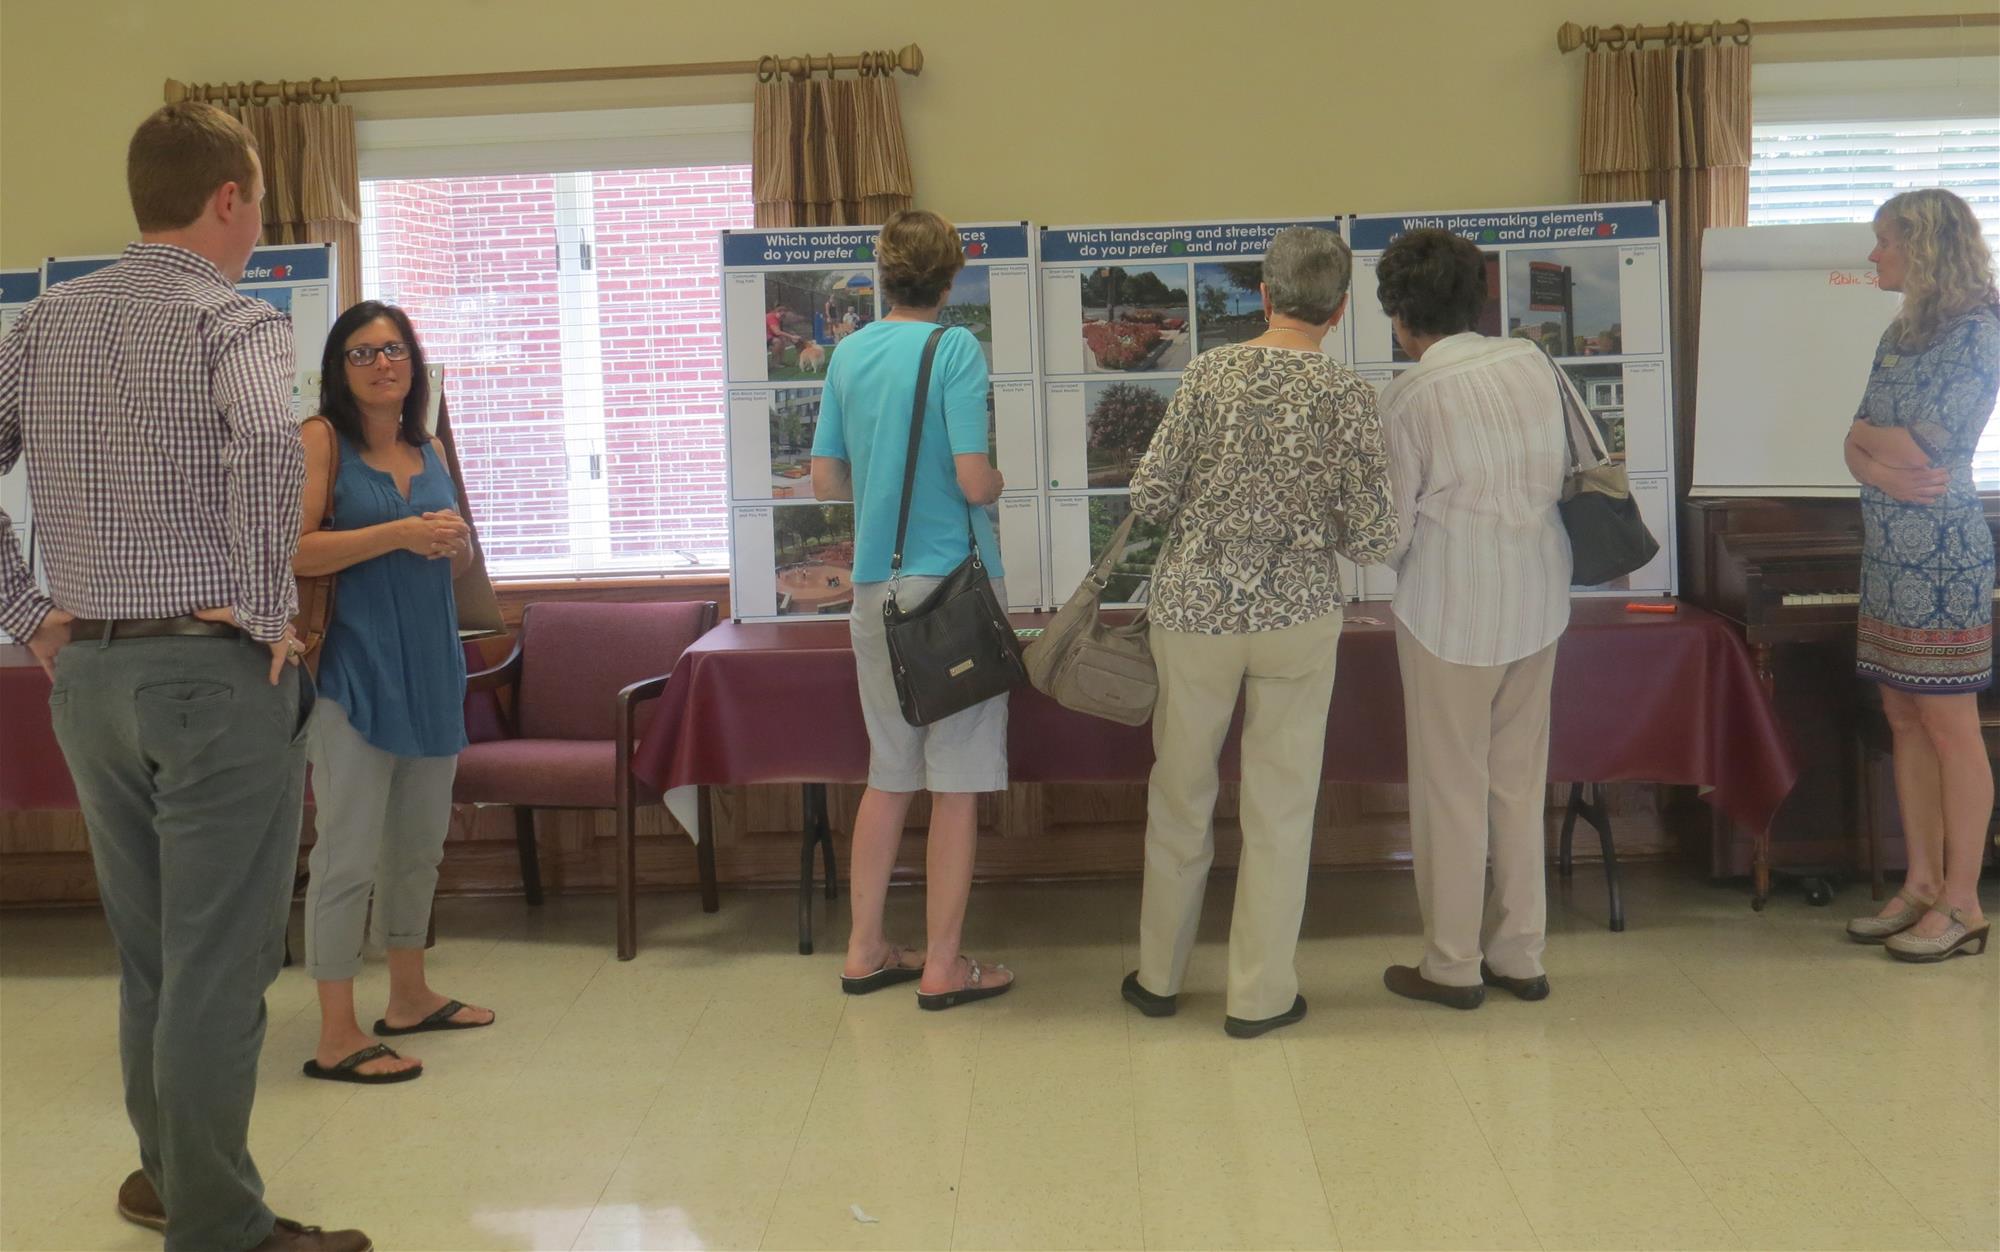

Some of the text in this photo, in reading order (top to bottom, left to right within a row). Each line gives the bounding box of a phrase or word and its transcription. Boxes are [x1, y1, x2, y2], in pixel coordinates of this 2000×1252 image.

[1403, 210, 1604, 231] Which placemaking elements
[1067, 231, 1107, 244] Which
[1111, 228, 1193, 242] landscaping
[1196, 226, 1222, 239] and
[1499, 227, 1525, 239] and
[1529, 226, 1551, 238] not
[1554, 223, 1595, 239] prefer
[766, 234, 807, 247] Which
[811, 233, 863, 246] outdoor
[763, 249, 782, 260] do
[785, 250, 810, 262] you
[814, 247, 854, 262] prefer
[1080, 239, 1273, 258] do you prefer and not prefe
[242, 266, 273, 279] refer
